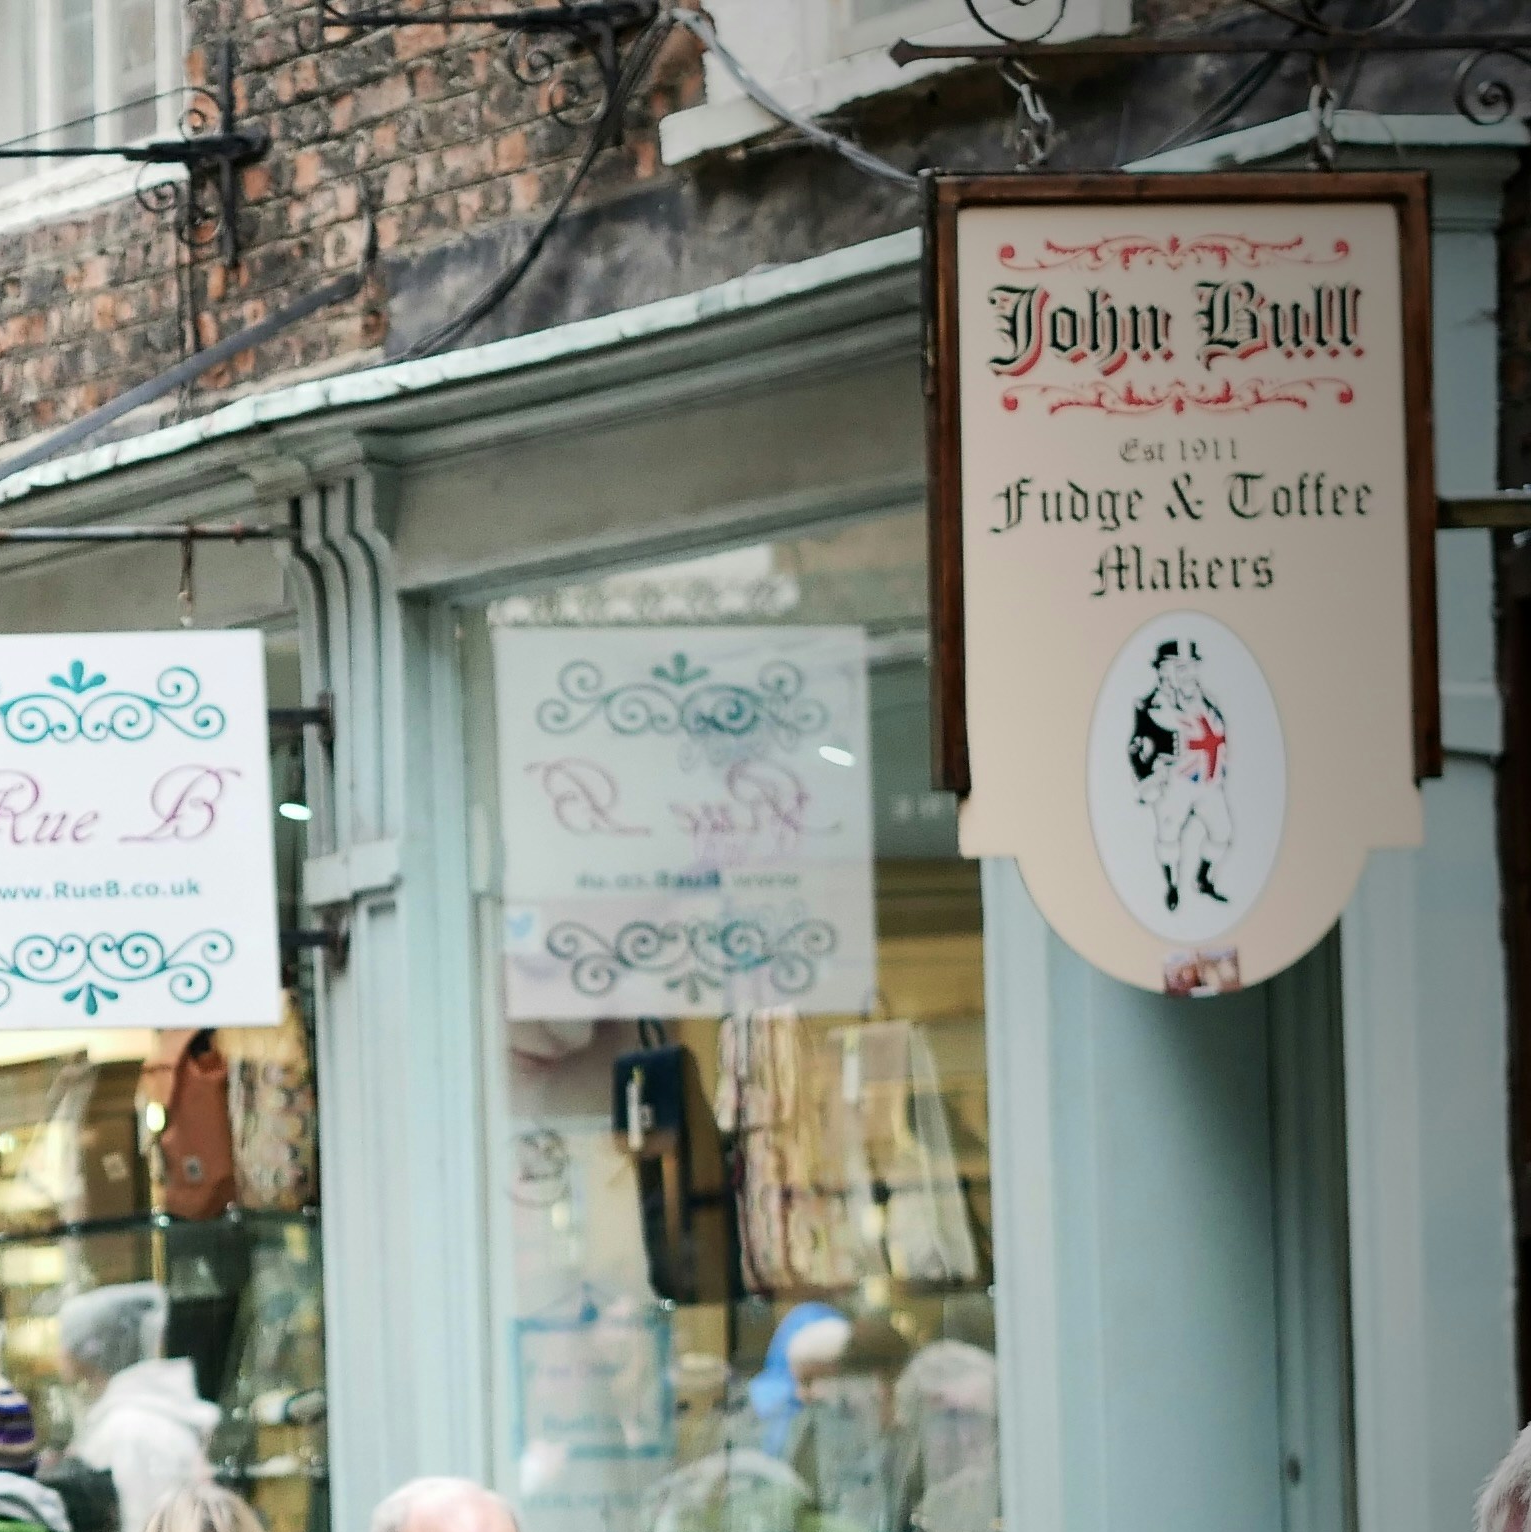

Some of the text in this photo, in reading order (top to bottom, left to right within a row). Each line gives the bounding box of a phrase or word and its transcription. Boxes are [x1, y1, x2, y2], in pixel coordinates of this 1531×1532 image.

[989, 279, 1365, 376] John Bull
[1119, 437, 1238, 463] Est 1911
[989, 471, 1373, 534] Fudge & Toffee
[1090, 544, 1276, 597] Makers
[118, 763, 242, 844] B
